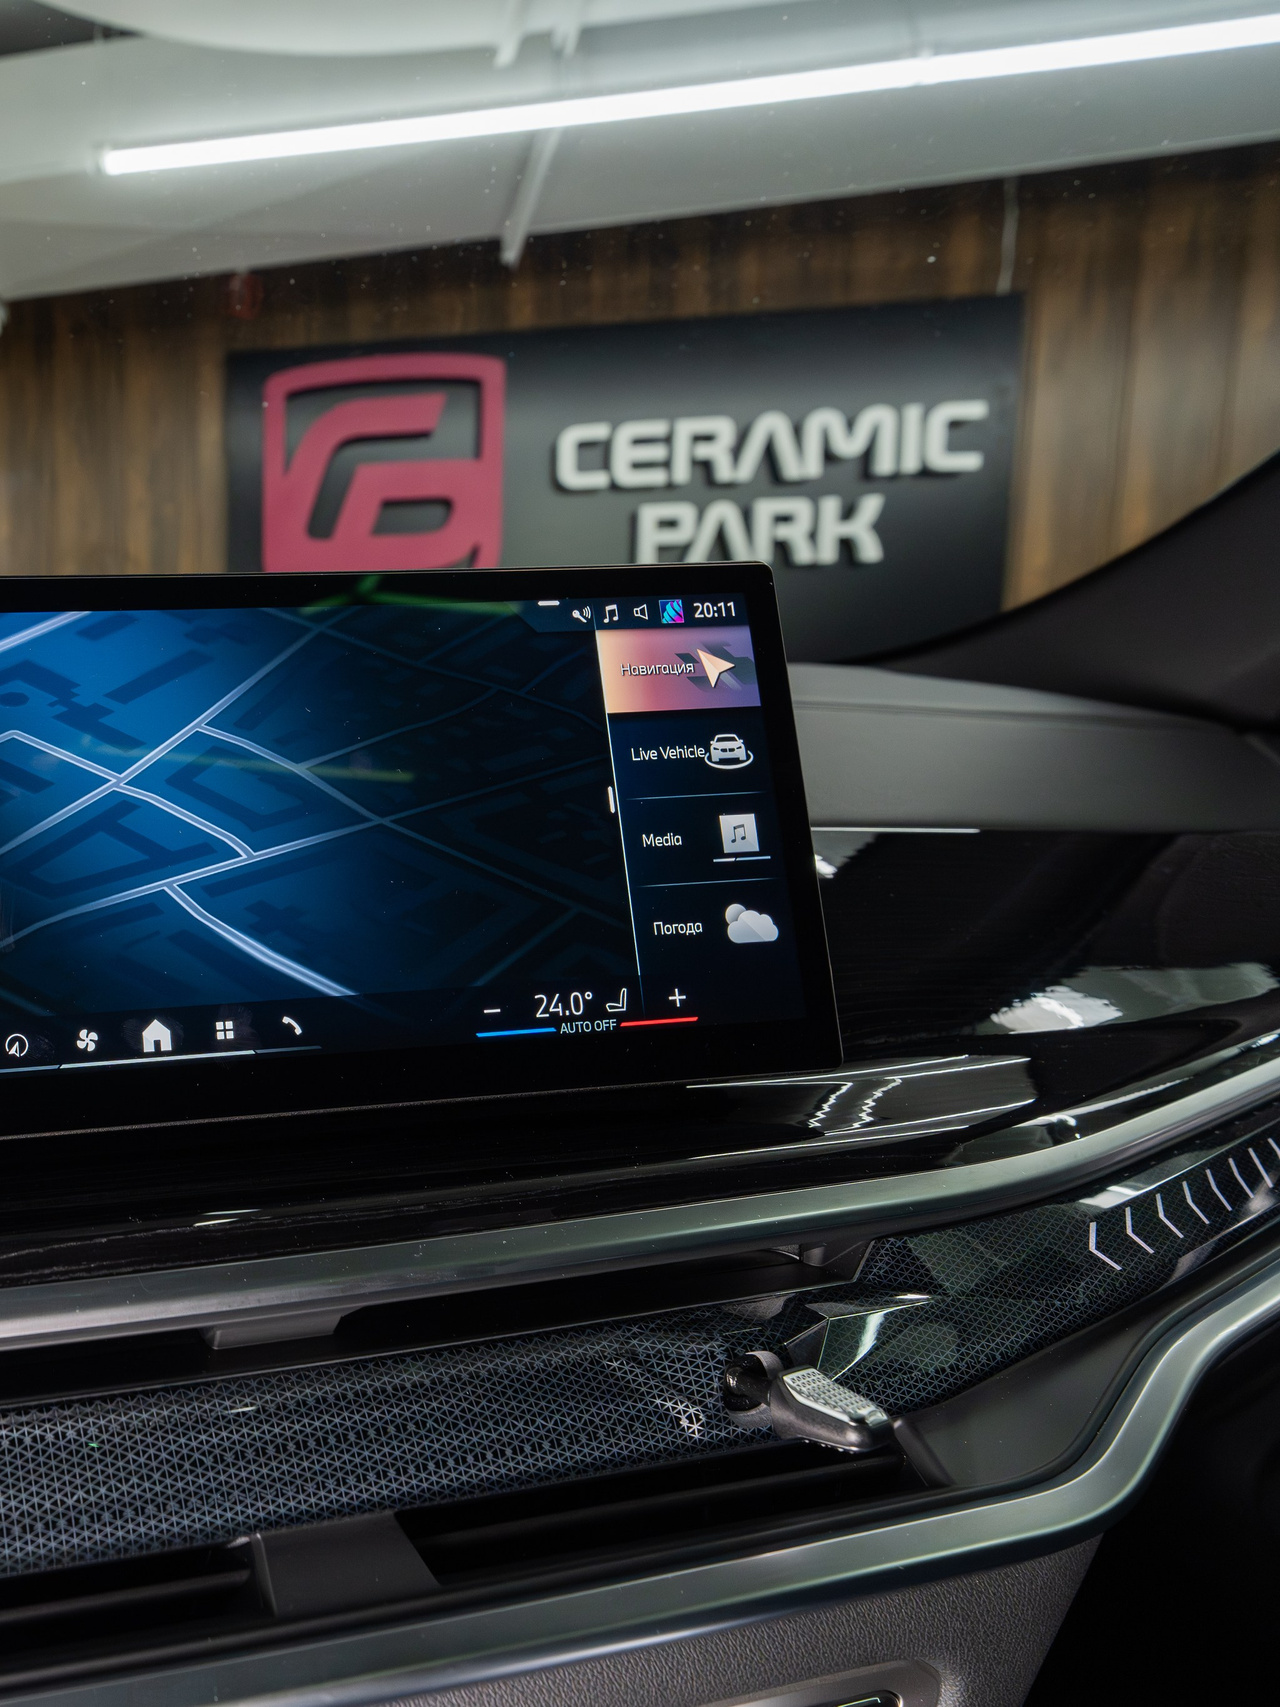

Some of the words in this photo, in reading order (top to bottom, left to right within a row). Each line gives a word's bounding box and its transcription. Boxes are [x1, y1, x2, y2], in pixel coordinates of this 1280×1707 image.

[556, 400, 989, 491] CERAMIC
[637, 494, 886, 566] PARK
[693, 601, 736, 618] 20:11
[620, 663, 695, 675] Навигация
[631, 747, 658, 761] Live
[660, 744, 705, 760] Vehicle
[642, 832, 683, 848] Media
[653, 921, 703, 937] Погода
[535, 991, 593, 1018] 24.0°
[560, 1020, 592, 1035] AUTO
[594, 1018, 617, 1032] OFF
